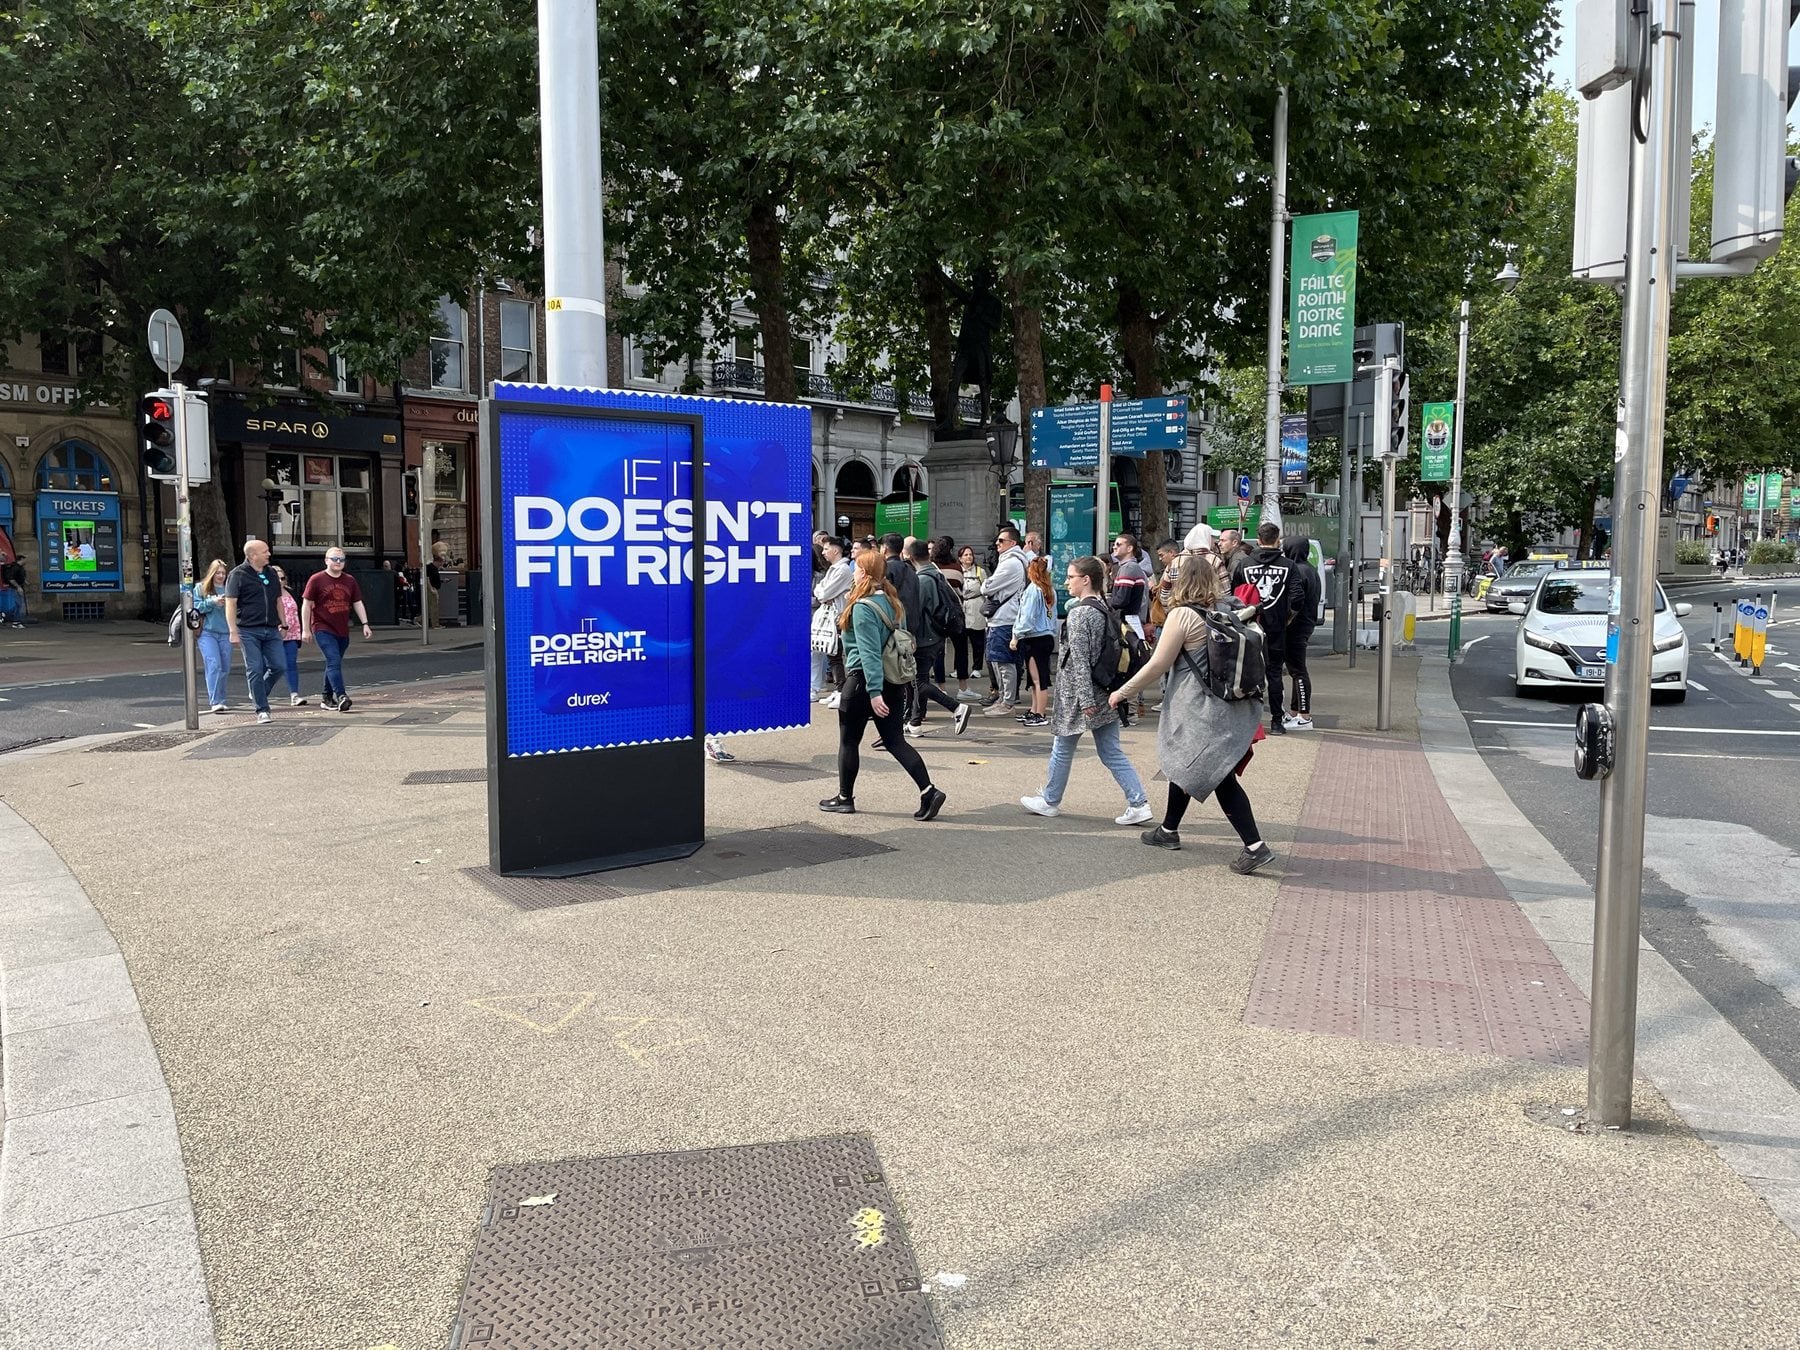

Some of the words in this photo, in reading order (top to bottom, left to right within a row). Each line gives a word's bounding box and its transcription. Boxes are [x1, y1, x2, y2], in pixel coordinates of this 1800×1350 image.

[1300, 274, 1344, 291] FÁILTE
[1298, 290, 1346, 307] ROIMH
[1298, 307, 1344, 323] NOTRE
[1300, 323, 1342, 338] DAME
[0, 384, 28, 401] SM
[457, 409, 480, 422] dub
[246, 419, 307, 434] SPAR
[624, 459, 661, 495] IF
[674, 461, 710, 496] IT
[52, 500, 106, 511] TICKETS
[514, 496, 802, 542] DOESN'T
[516, 545, 614, 587] FIT
[626, 545, 802, 585] RIGHT
[582, 618, 598, 633] IT
[530, 631, 646, 653] DOESN'T
[530, 650, 581, 666] FEEL
[584, 648, 646, 664] RIGHT.
[567, 692, 609, 708] durex
[648, 1188, 732, 1202] TRAFFIC
[645, 1298, 743, 1318] TRAFFIC
